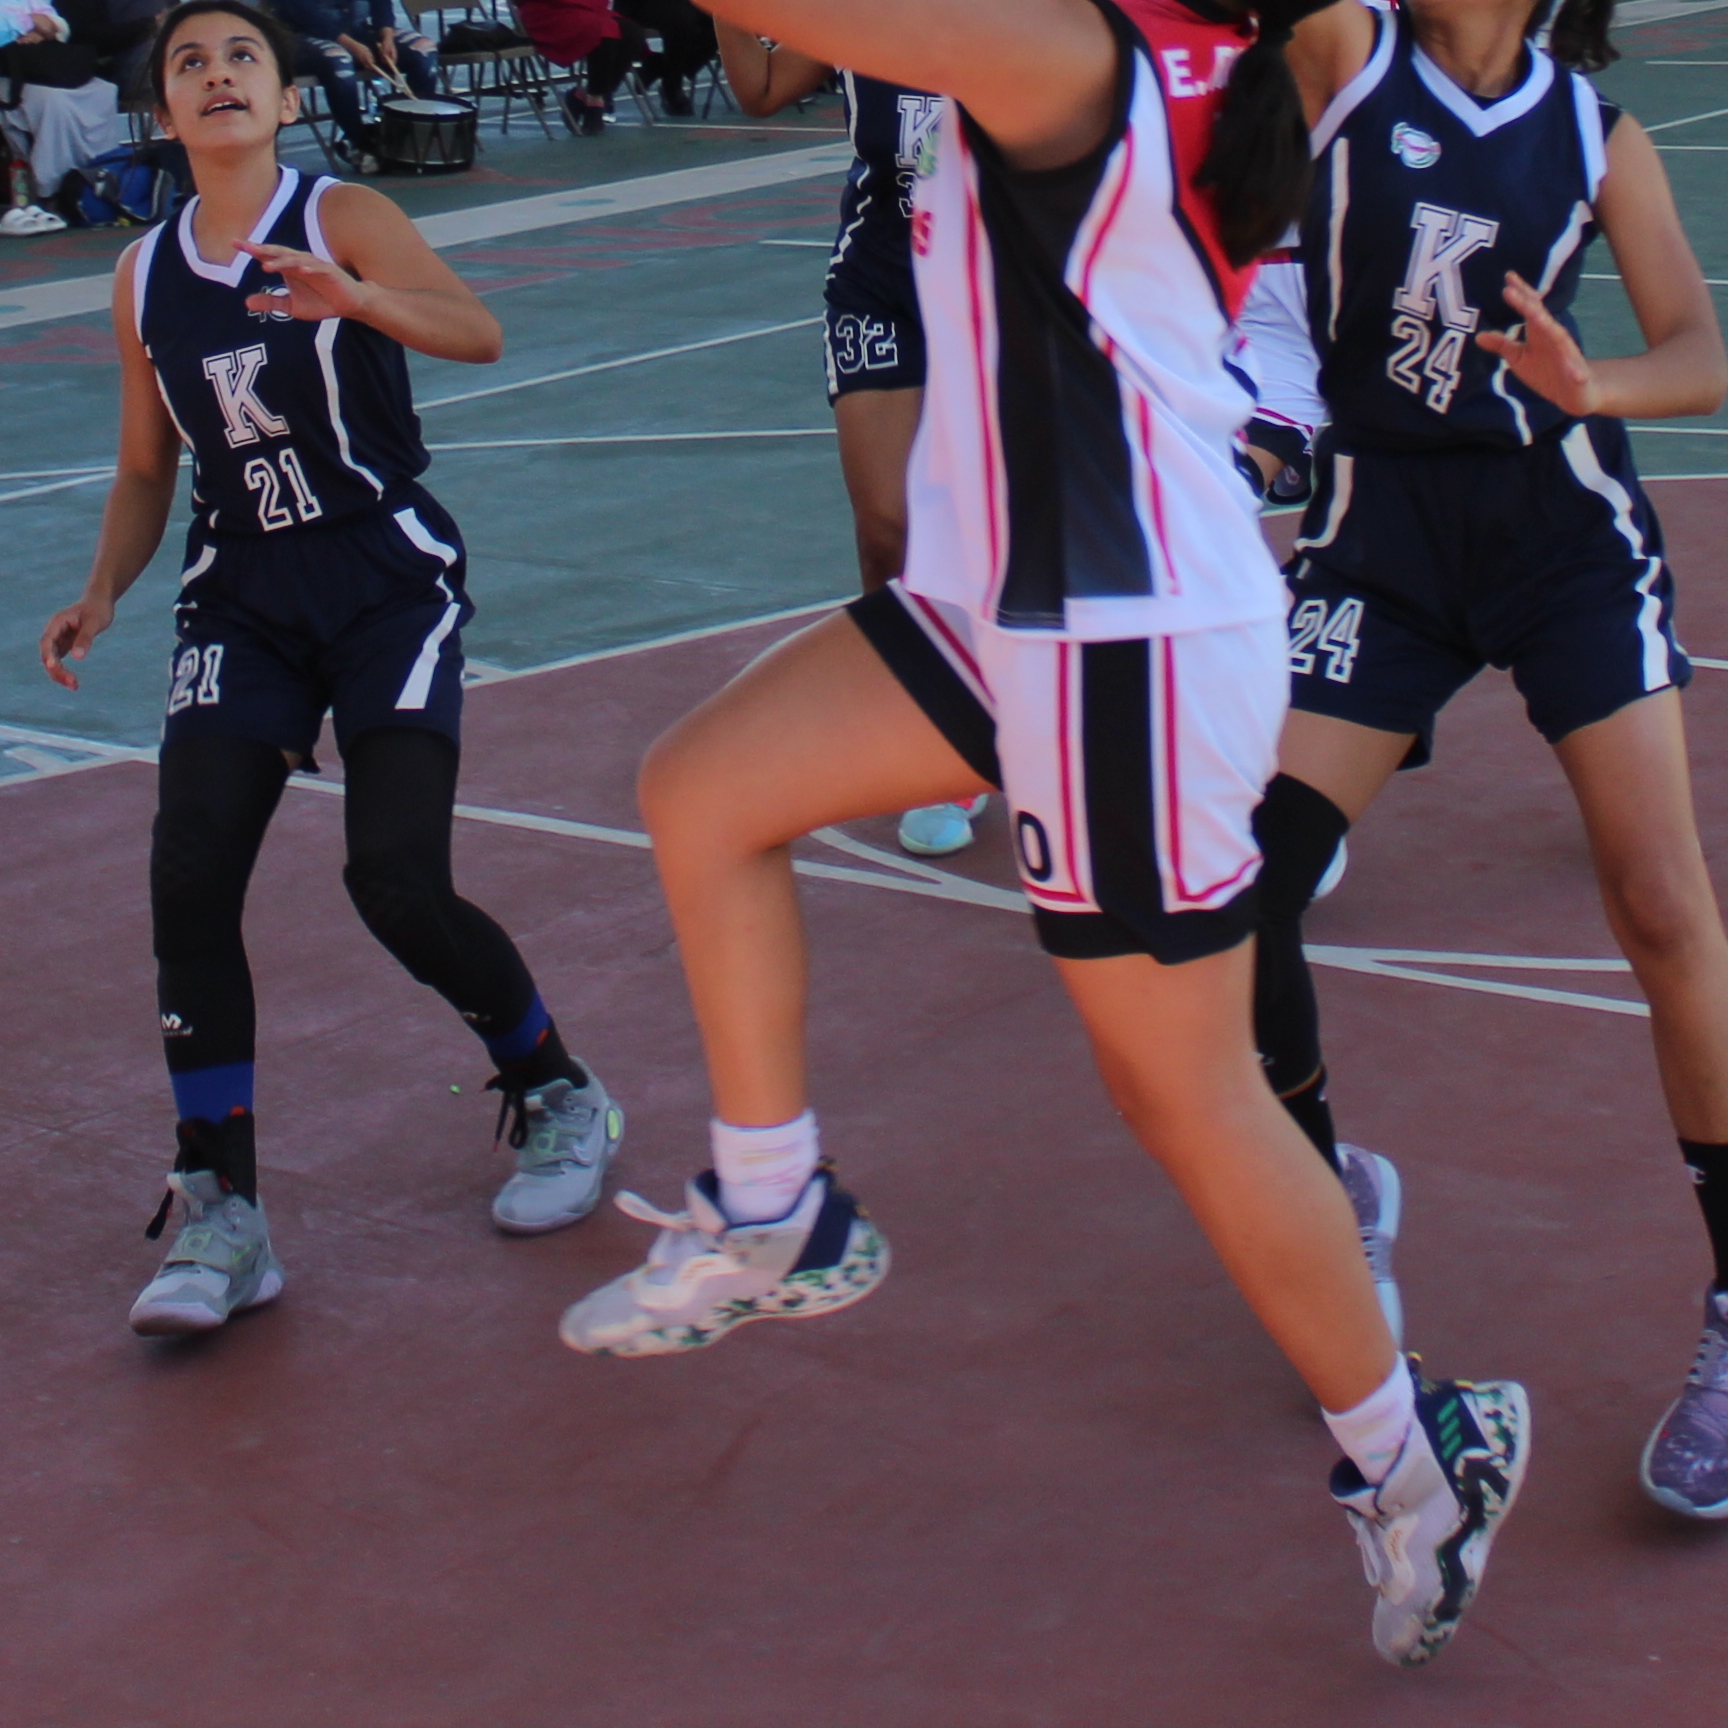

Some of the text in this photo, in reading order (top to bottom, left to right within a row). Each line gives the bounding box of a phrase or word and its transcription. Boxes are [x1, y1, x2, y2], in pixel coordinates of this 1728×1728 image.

[1392, 202, 1500, 333] K
[836, 314, 898, 374] 32
[1386, 314, 1467, 414] 24
[202, 343, 290, 449] K
[244, 448, 323, 532] 21
[168, 644, 224, 716] 21
[1289, 597, 1364, 684] 24
